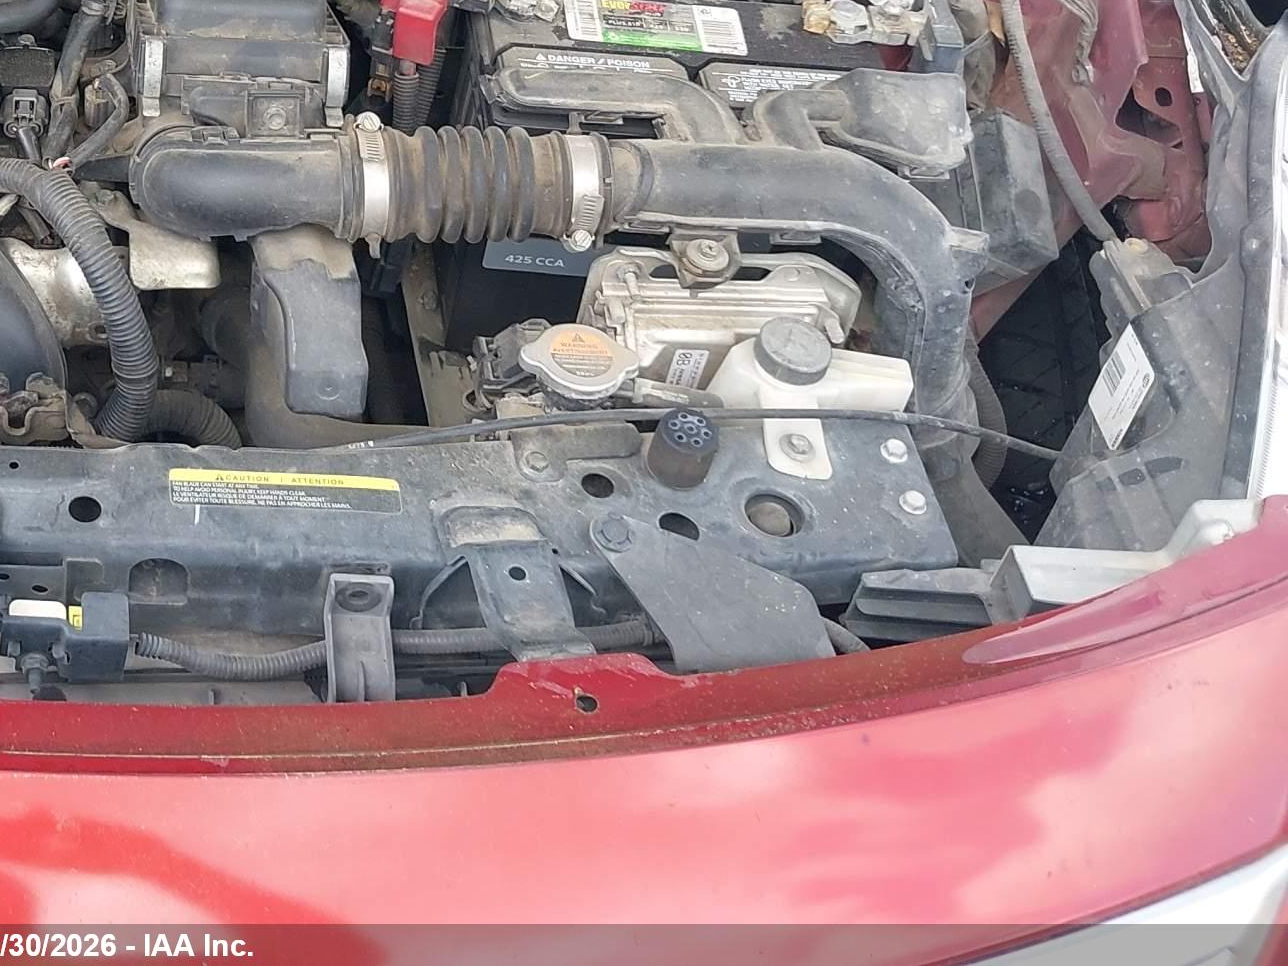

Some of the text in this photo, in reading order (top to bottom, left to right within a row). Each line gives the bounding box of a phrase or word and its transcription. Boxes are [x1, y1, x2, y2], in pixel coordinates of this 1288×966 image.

[548, 54, 596, 64] DANGER
[606, 58, 650, 68] POISON
[505, 254, 565, 268] 425 CCA
